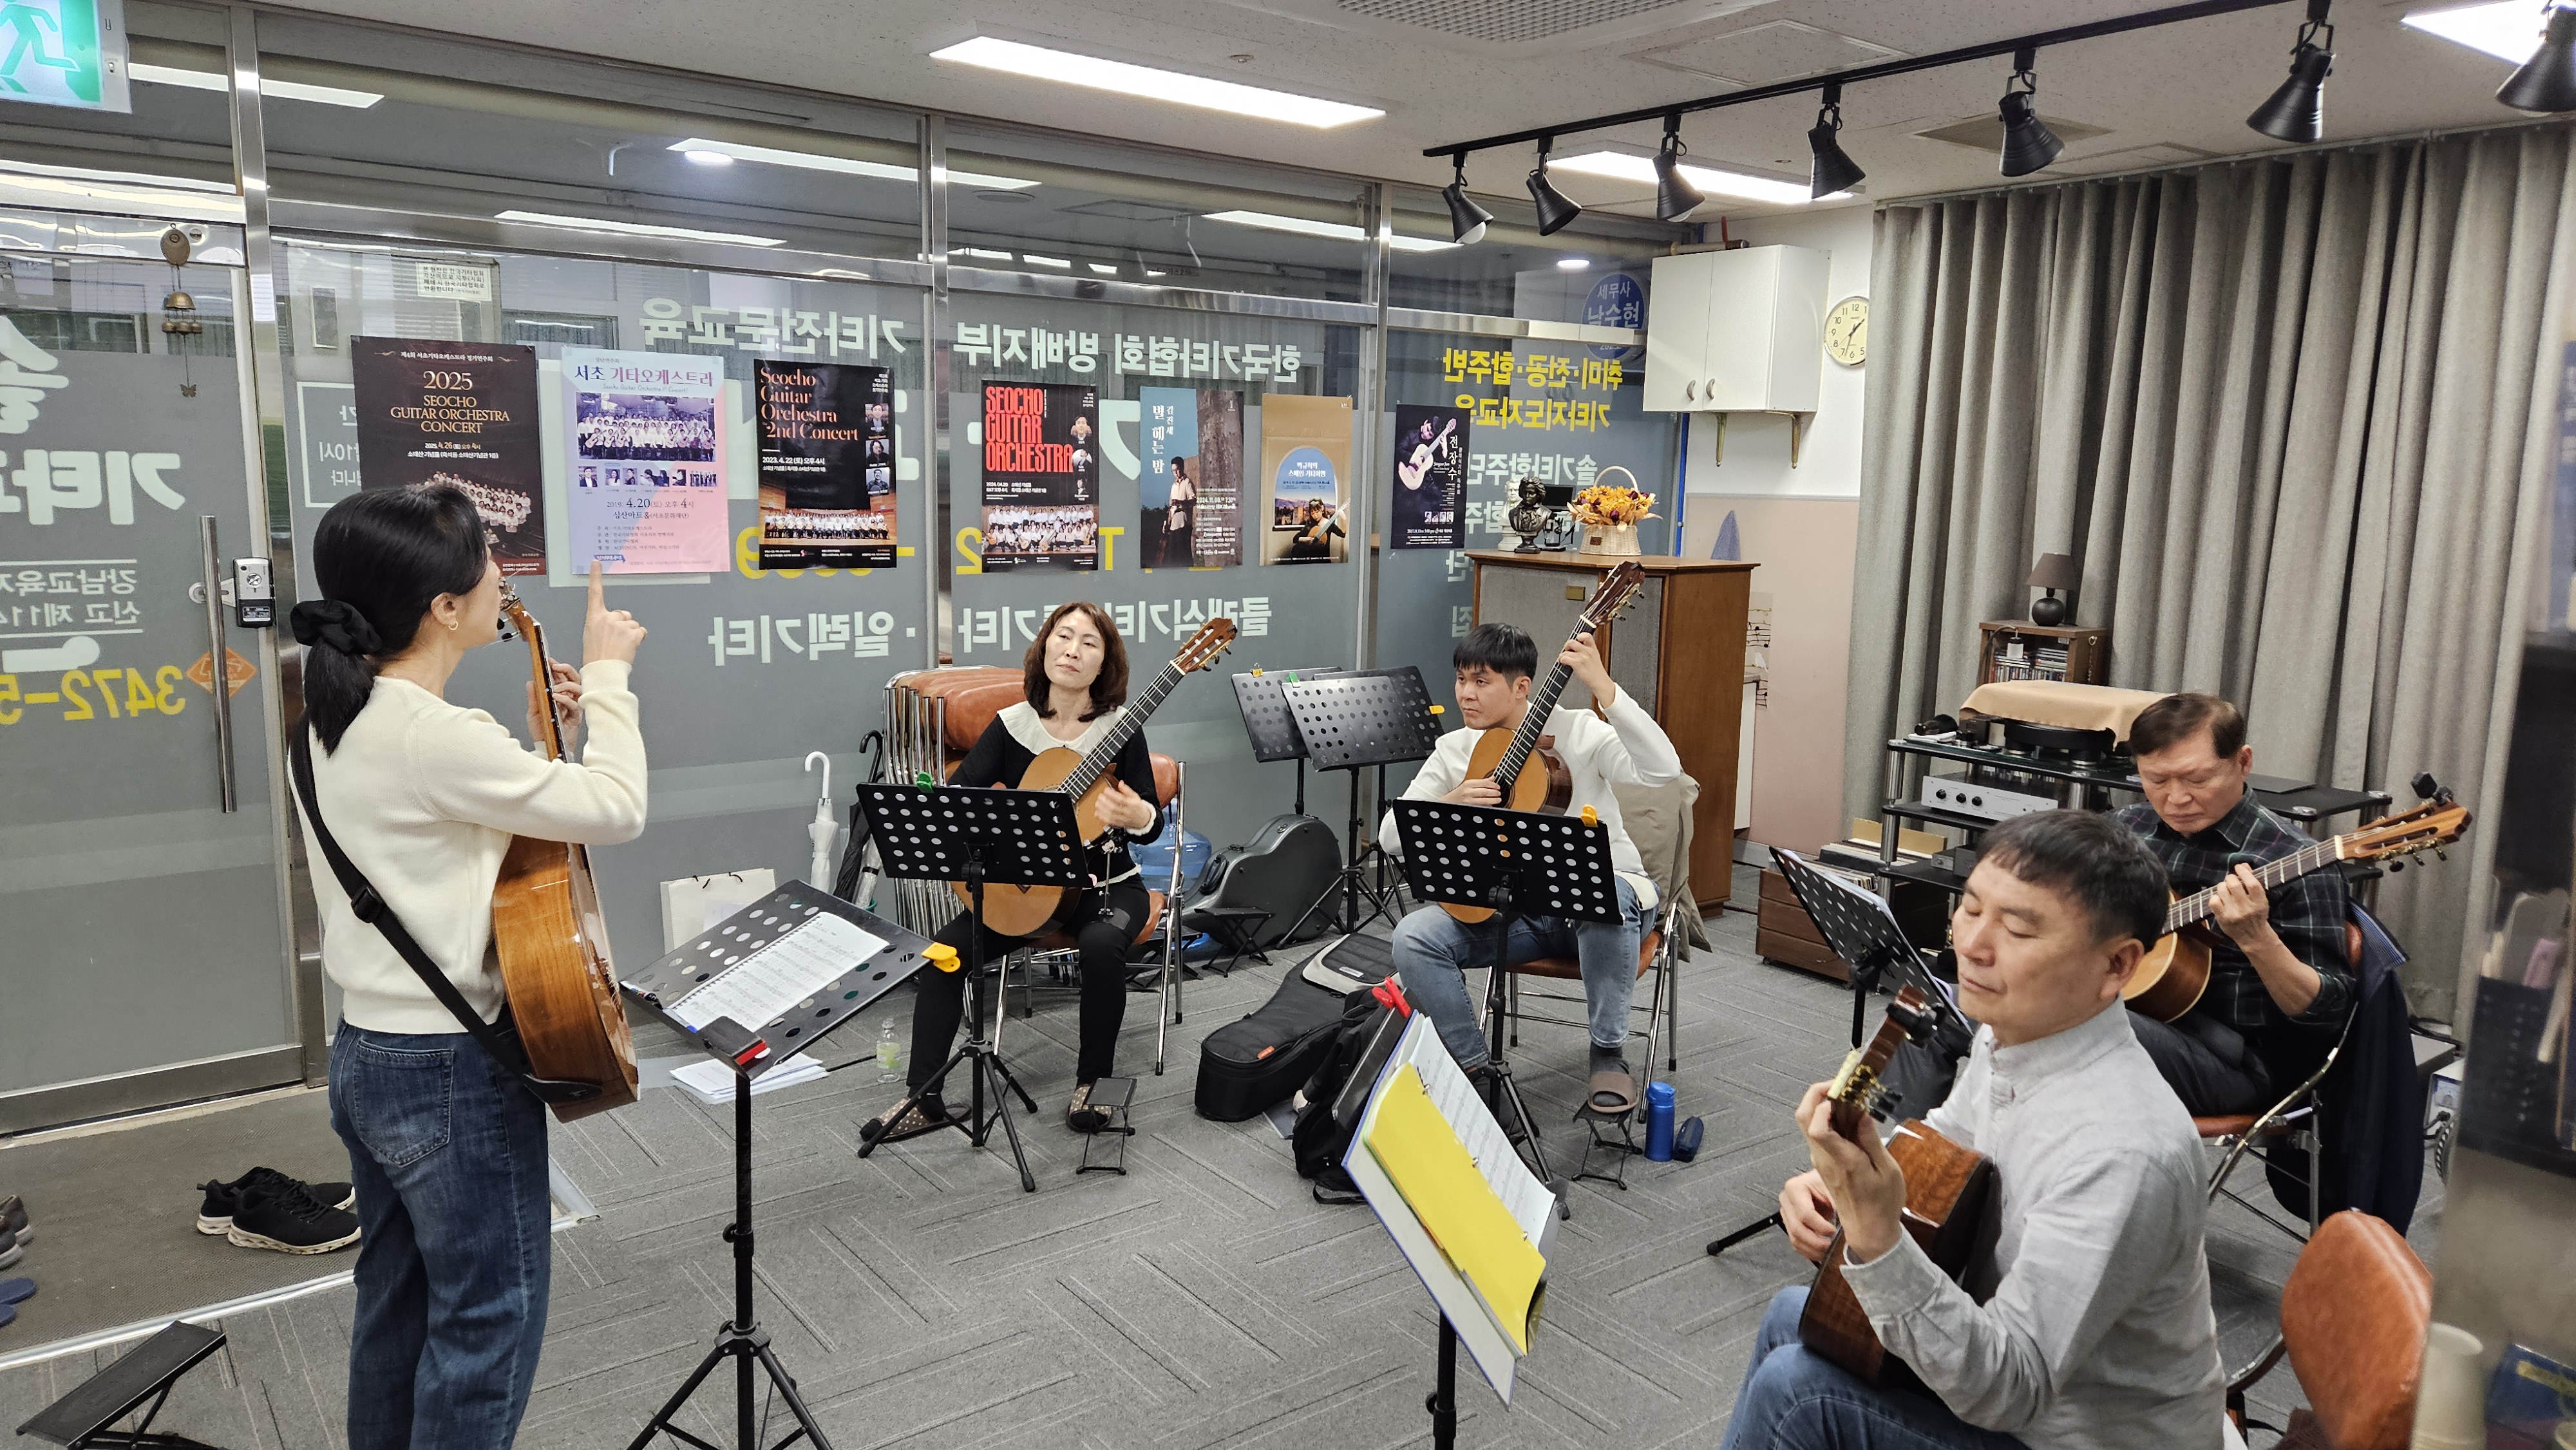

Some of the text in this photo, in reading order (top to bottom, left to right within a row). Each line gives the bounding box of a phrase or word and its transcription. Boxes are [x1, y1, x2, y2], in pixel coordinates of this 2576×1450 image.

[1598, 281, 1631, 299] 세무사
[423, 371, 473, 390] 2025
[574, 365, 714, 387] 서초 기타오케스트라
[761, 366, 817, 386] Seocho
[423, 395, 477, 408] SEOCHO
[761, 386, 812, 404] Guitar
[985, 386, 1044, 415] SEOCHO
[390, 407, 510, 422] GUITAR ORCHESTRA
[761, 404, 837, 422] Orchestra
[421, 420, 483, 433] CONCERT
[766, 421, 858, 441] 2nd Concert
[985, 413, 1043, 444] GUITAR
[1151, 405, 1164, 474] 별 헤는 밤
[985, 442, 1074, 473] ORCHESTRA
